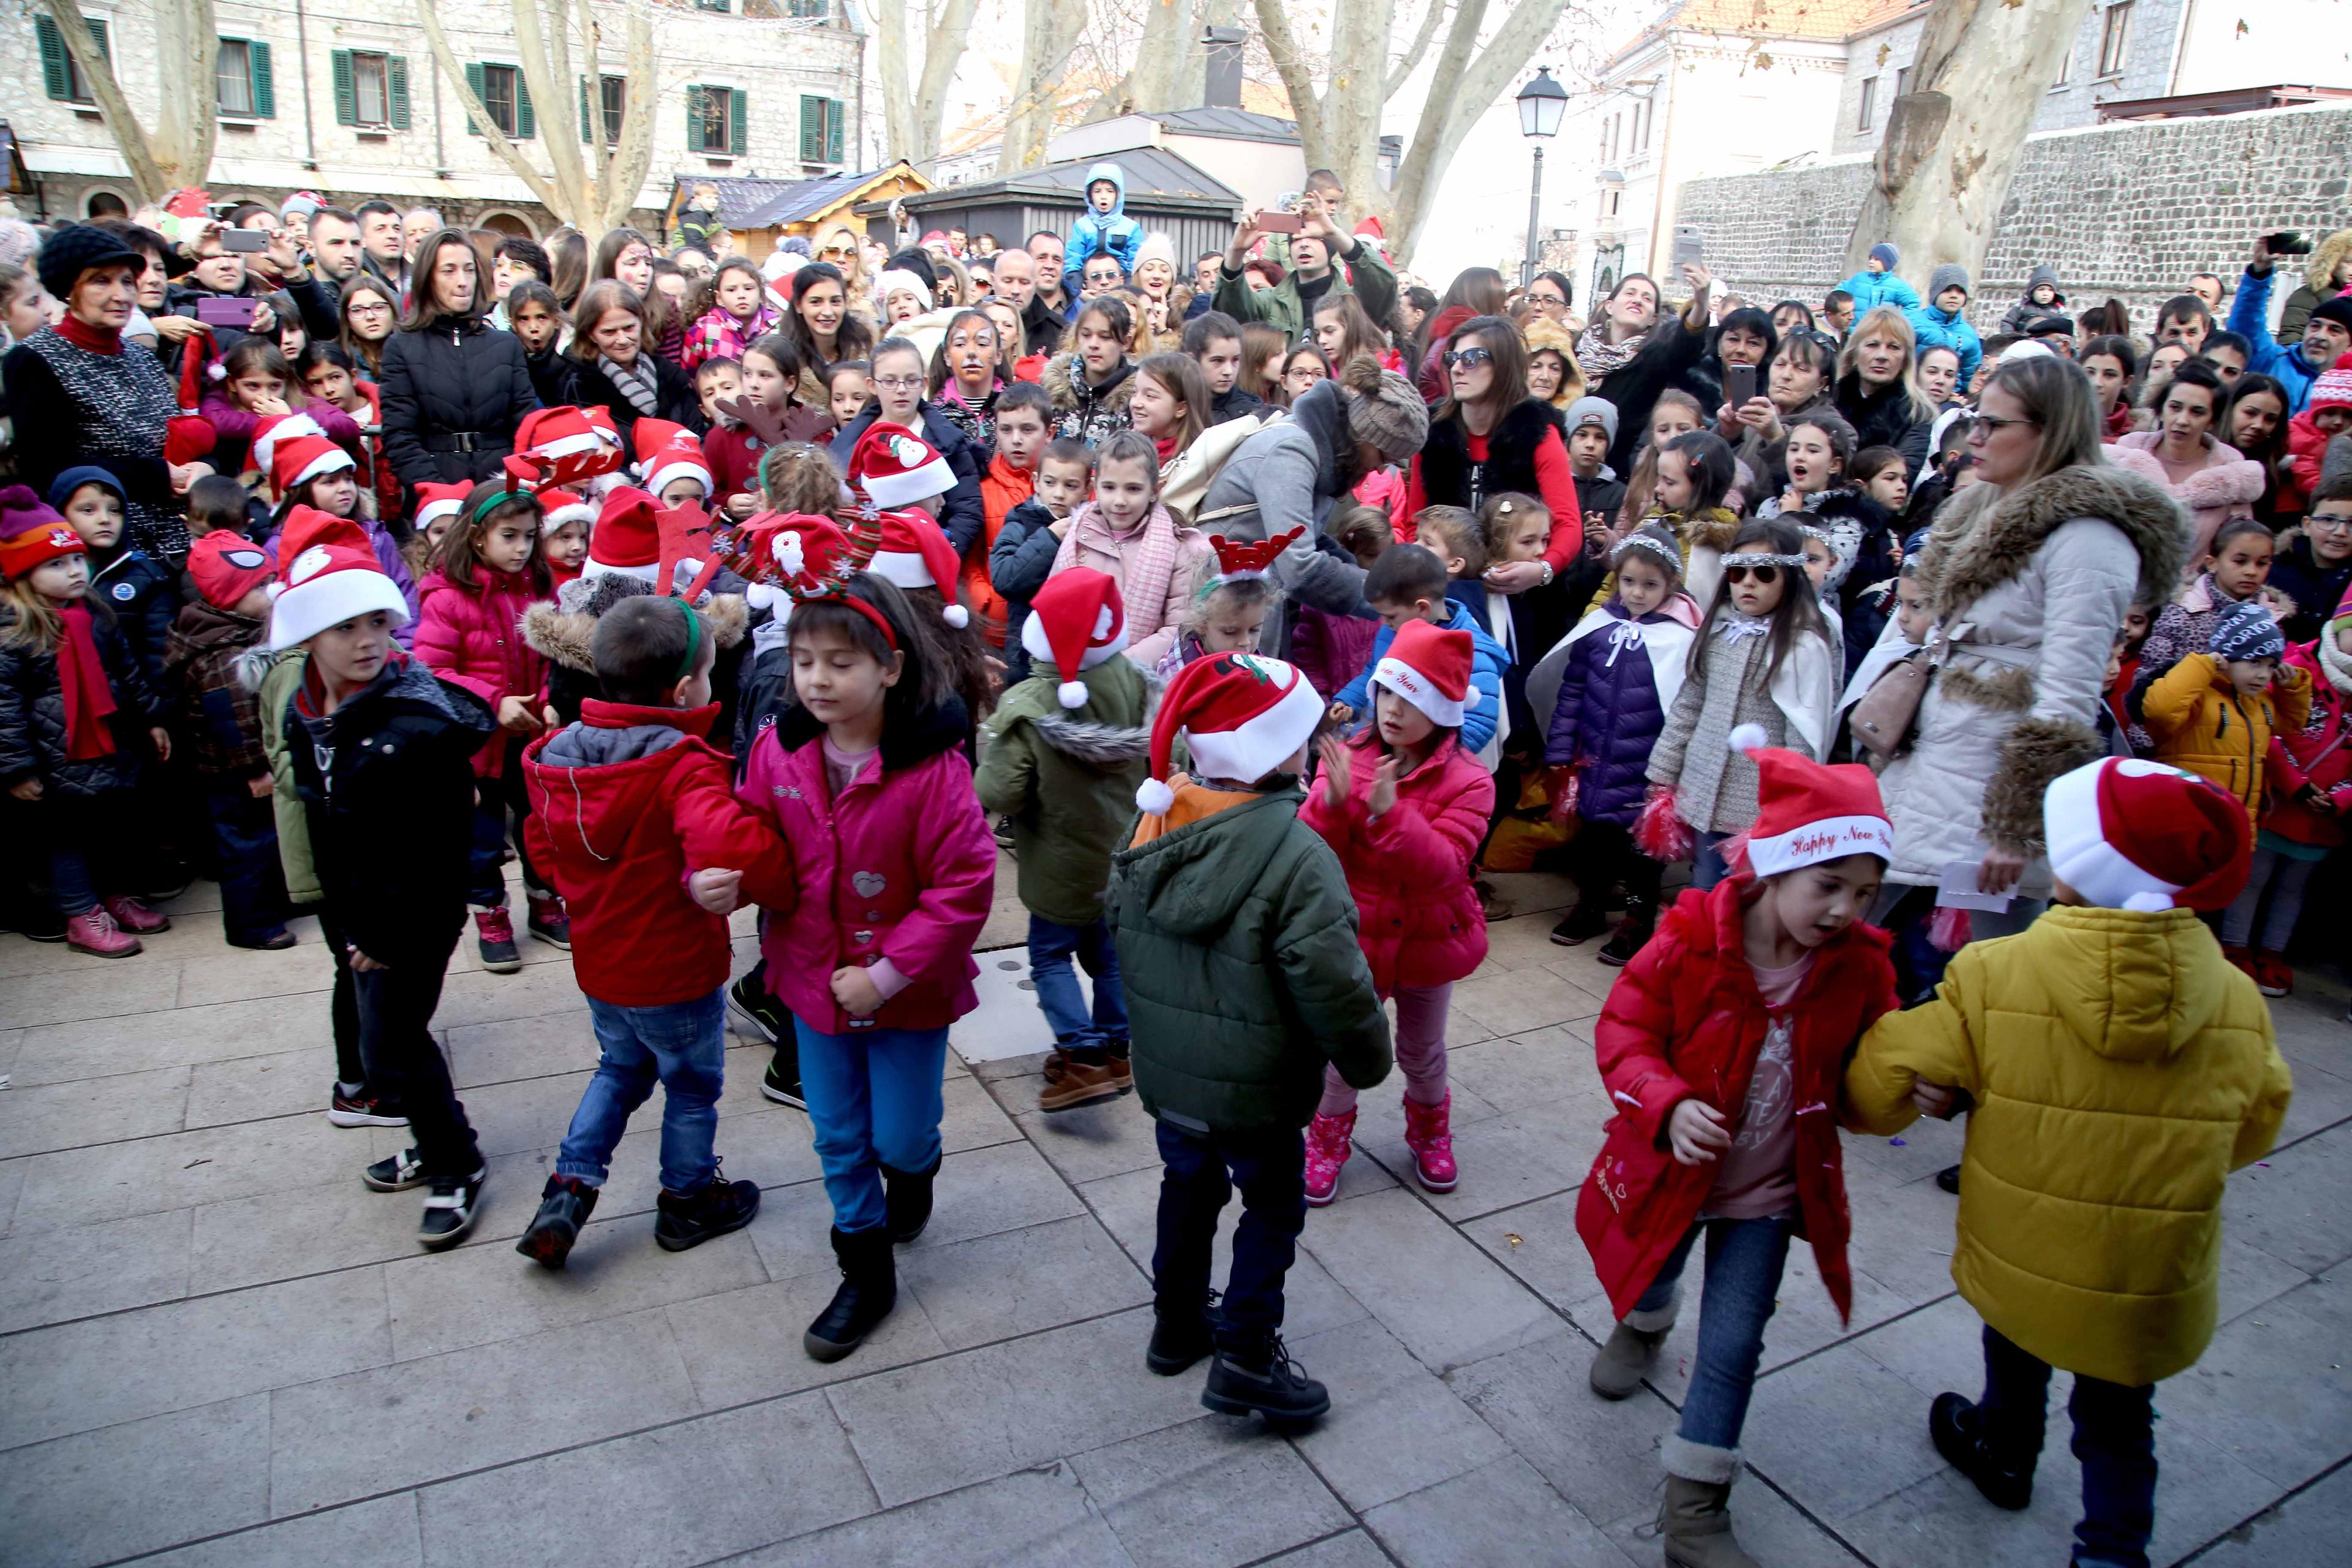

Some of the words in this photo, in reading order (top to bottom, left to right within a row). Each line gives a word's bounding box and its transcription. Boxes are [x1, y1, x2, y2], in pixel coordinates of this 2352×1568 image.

[2222, 621, 2271, 652] PORTO
[1397, 672, 1420, 693] Year
[1792, 832, 1838, 857] Happy
[1843, 824, 1875, 841] New
